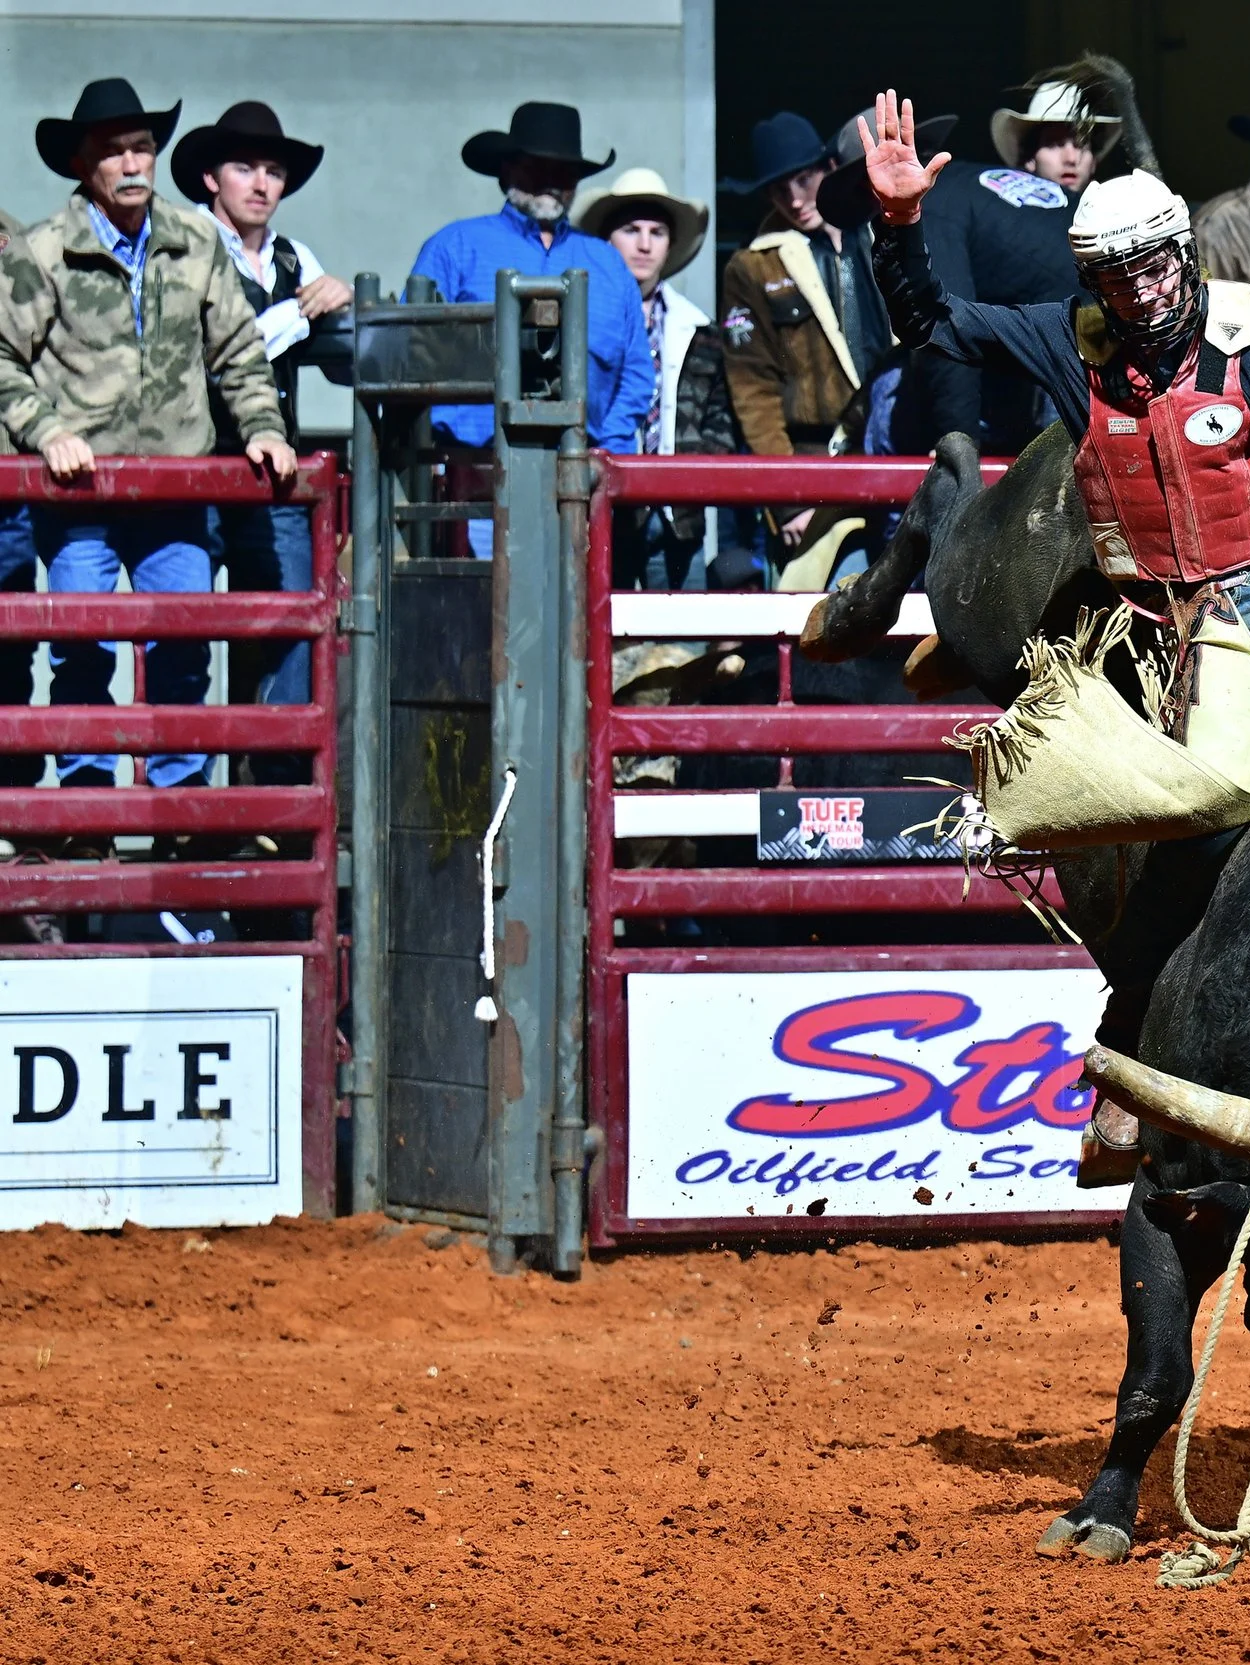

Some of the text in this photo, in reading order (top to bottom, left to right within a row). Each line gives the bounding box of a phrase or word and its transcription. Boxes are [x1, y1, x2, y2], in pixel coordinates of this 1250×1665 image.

[1101, 223, 1138, 239] BAUER
[801, 800, 863, 821] TUFF
[829, 835, 863, 848] TOUR
[675, 1150, 941, 1195] Oilfield
